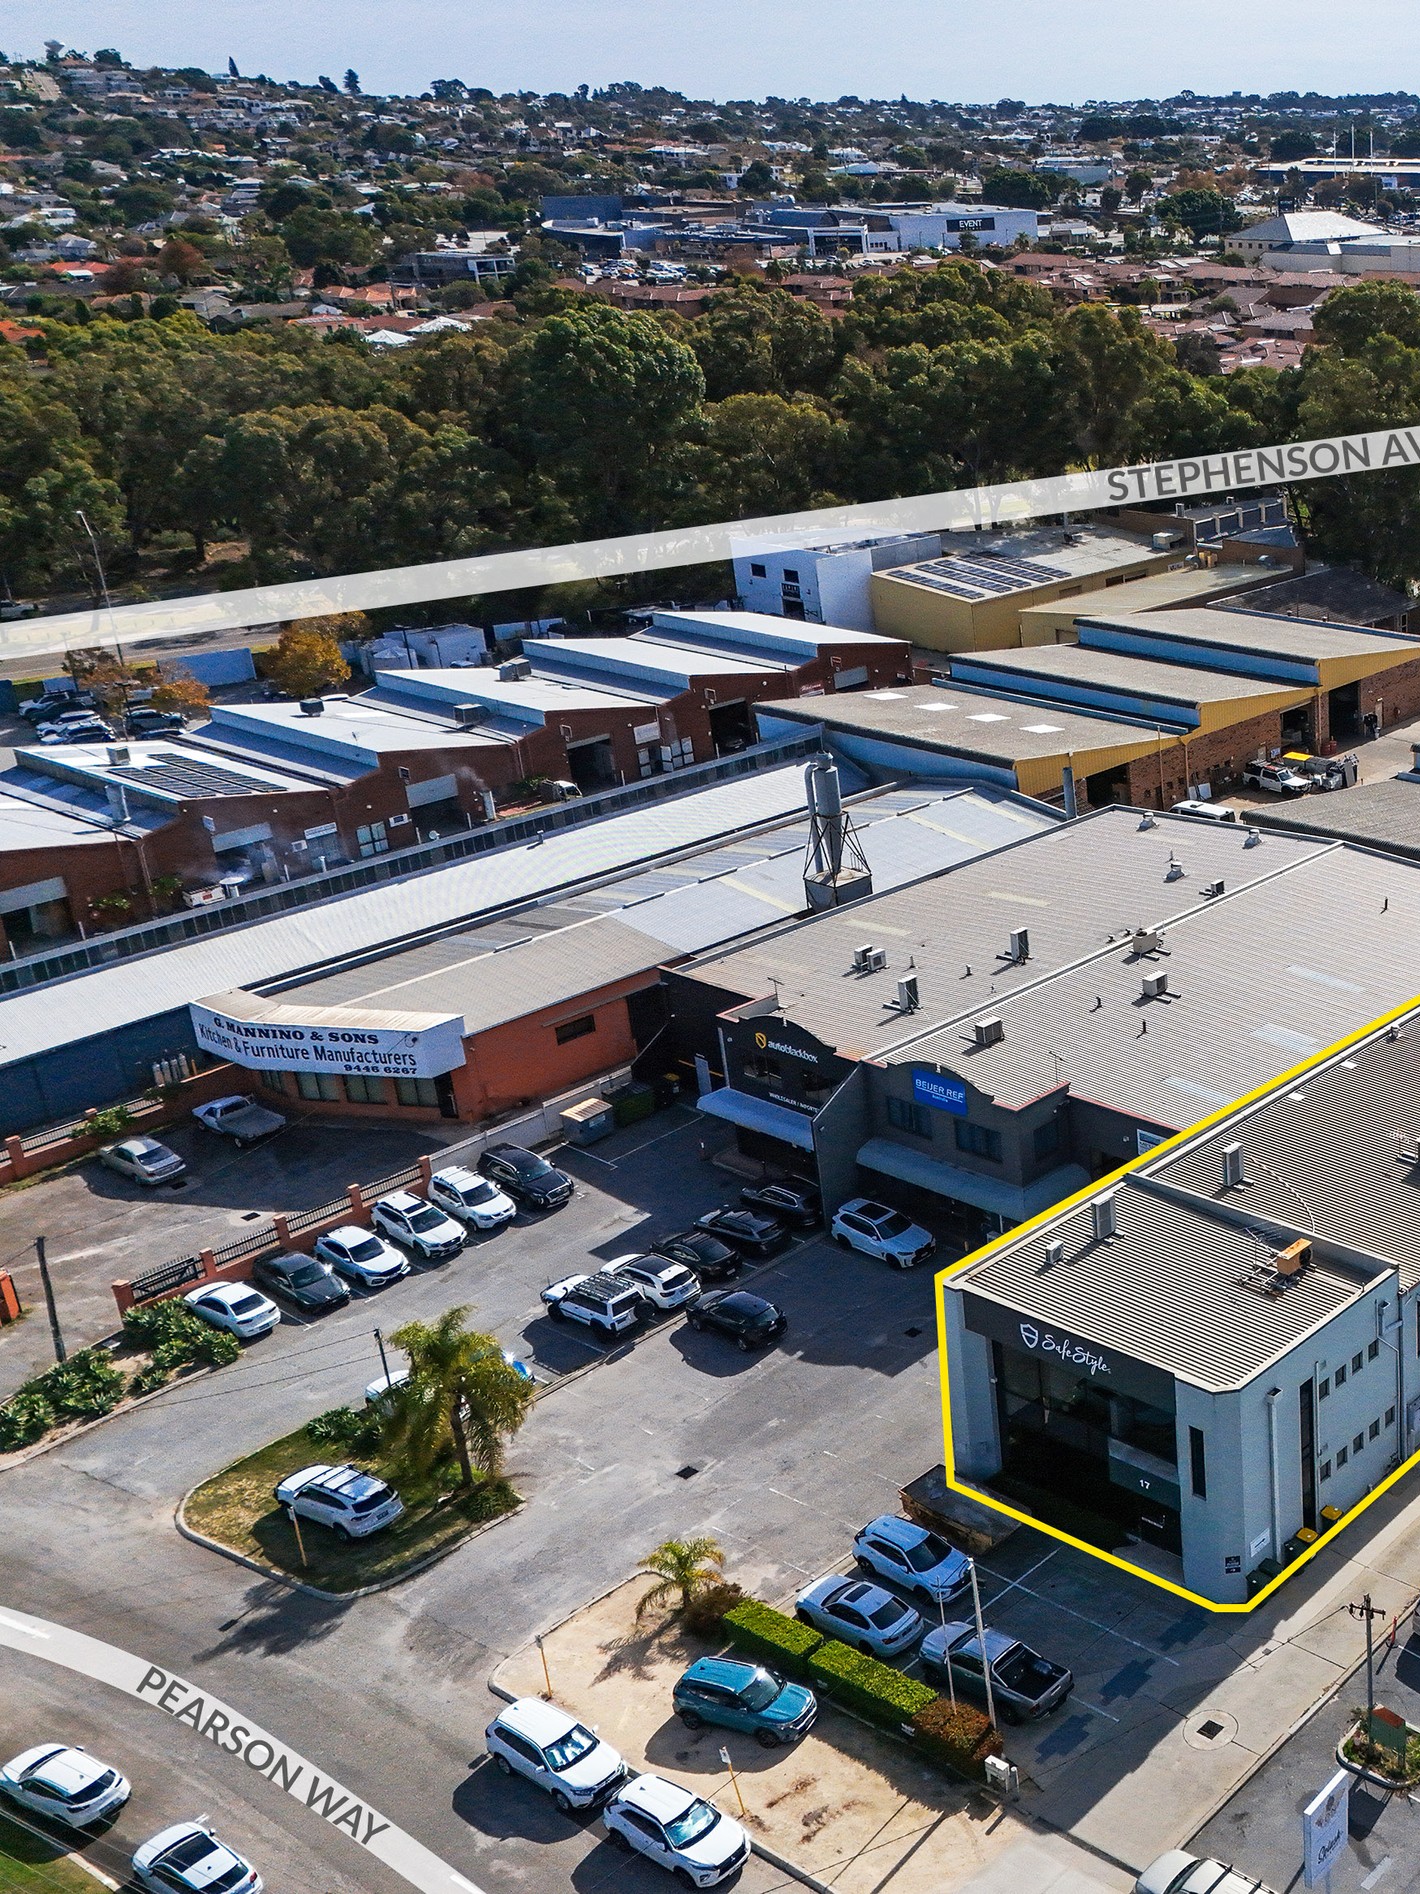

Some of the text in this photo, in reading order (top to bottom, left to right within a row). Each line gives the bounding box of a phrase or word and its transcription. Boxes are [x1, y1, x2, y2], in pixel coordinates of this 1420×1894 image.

[959, 219, 983, 228] EVENT
[213, 1016, 379, 1045] G. MANNINO & SONS
[199, 1023, 416, 1067] Kitchen & Furniture Manufacturers
[767, 1040, 819, 1063] autoblackbox
[343, 1063, 418, 1076] 9446 6267
[915, 1078, 945, 1095] BEIJER
[946, 1088, 964, 1100] REF
[1041, 1333, 1111, 1376] SafeStyle
[1139, 1479, 1151, 1490] 17
